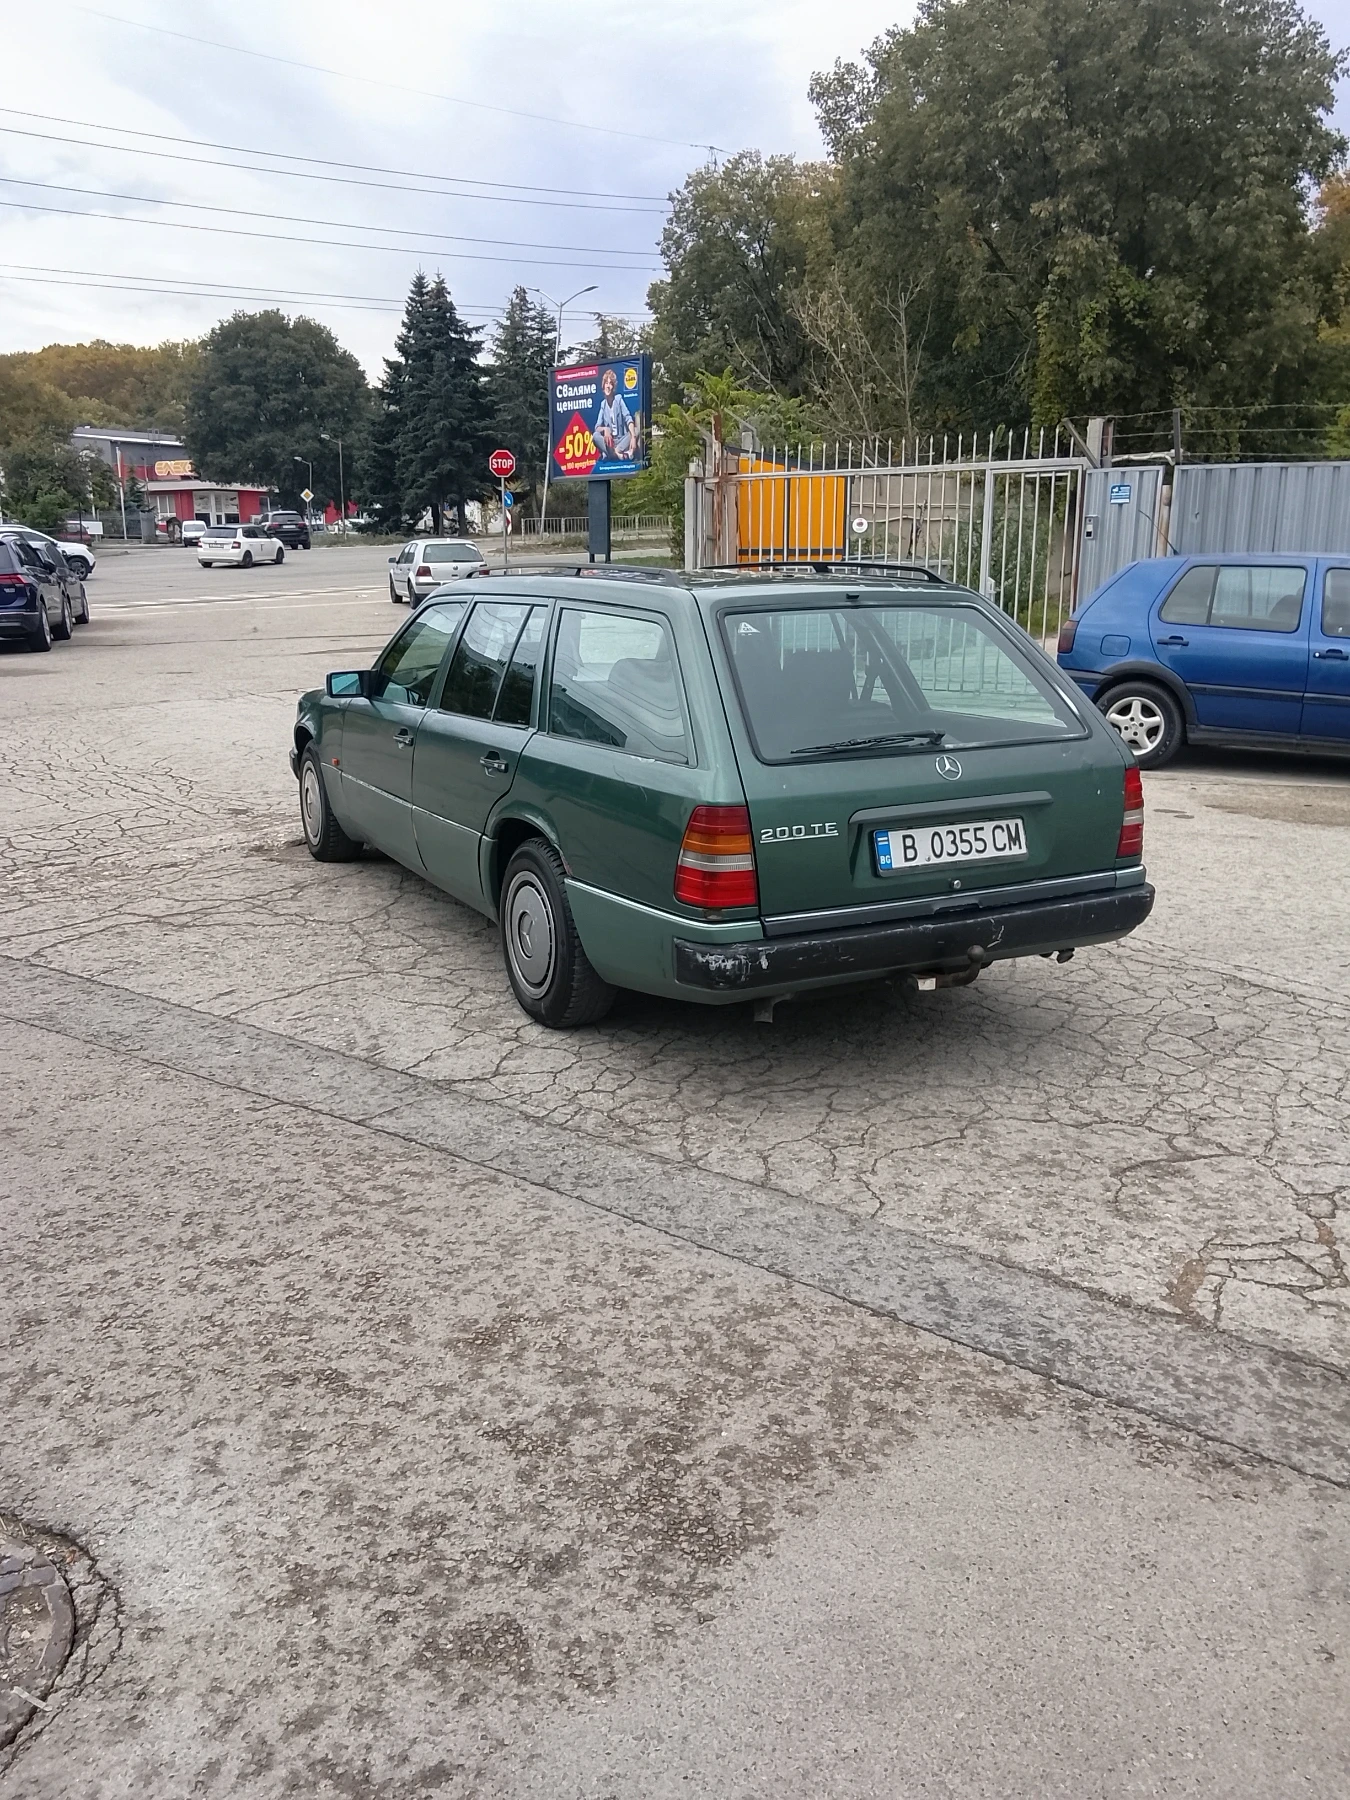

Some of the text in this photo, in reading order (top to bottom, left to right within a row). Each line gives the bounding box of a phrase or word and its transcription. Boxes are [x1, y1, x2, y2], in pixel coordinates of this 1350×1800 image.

[556, 384, 597, 398] Сваляме
[557, 398, 593, 413] цените
[492, 459, 513, 468] STOP
[761, 822, 838, 841] 200 TE
[902, 822, 1023, 863] B 0355 CM
[880, 855, 891, 864] BG
